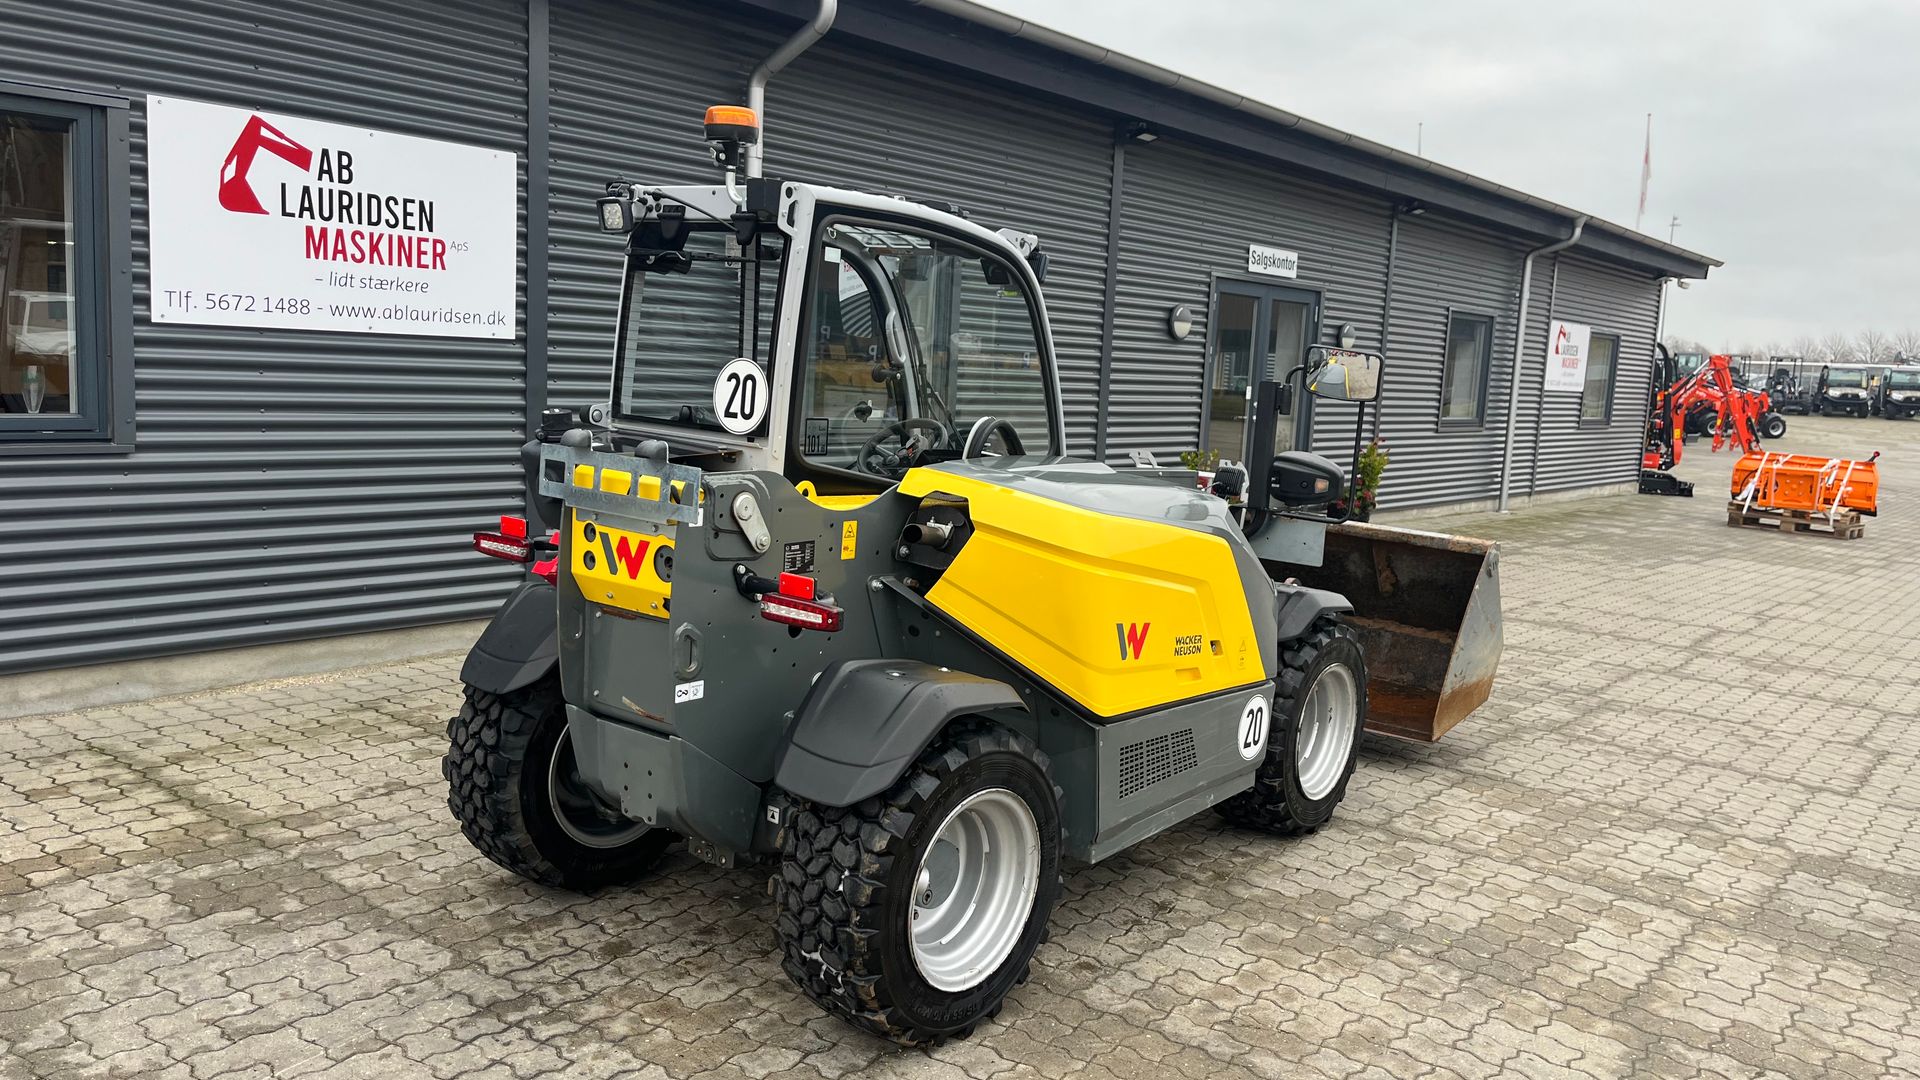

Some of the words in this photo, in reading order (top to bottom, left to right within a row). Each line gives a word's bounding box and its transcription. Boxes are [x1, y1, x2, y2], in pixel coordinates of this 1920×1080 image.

[317, 147, 354, 185] AB
[280, 182, 434, 233] LAURIDSEN
[305, 225, 446, 271] MASKINER
[449, 240, 469, 253] ApS
[1250, 250, 1296, 272] Salgskontor
[329, 271, 355, 290] lidt
[359, 275, 429, 294] stærkere
[164, 289, 198, 313] Tlf.
[205, 292, 256, 312] 5672
[263, 296, 311, 315] 1488
[329, 302, 506, 327] www.ablauridsen.dk
[723, 372, 758, 421] 20
[807, 435, 821, 453] 101
[1174, 645, 1202, 657] NEUSON
[1175, 634, 1203, 646] WACKER
[1243, 706, 1264, 749] 20
